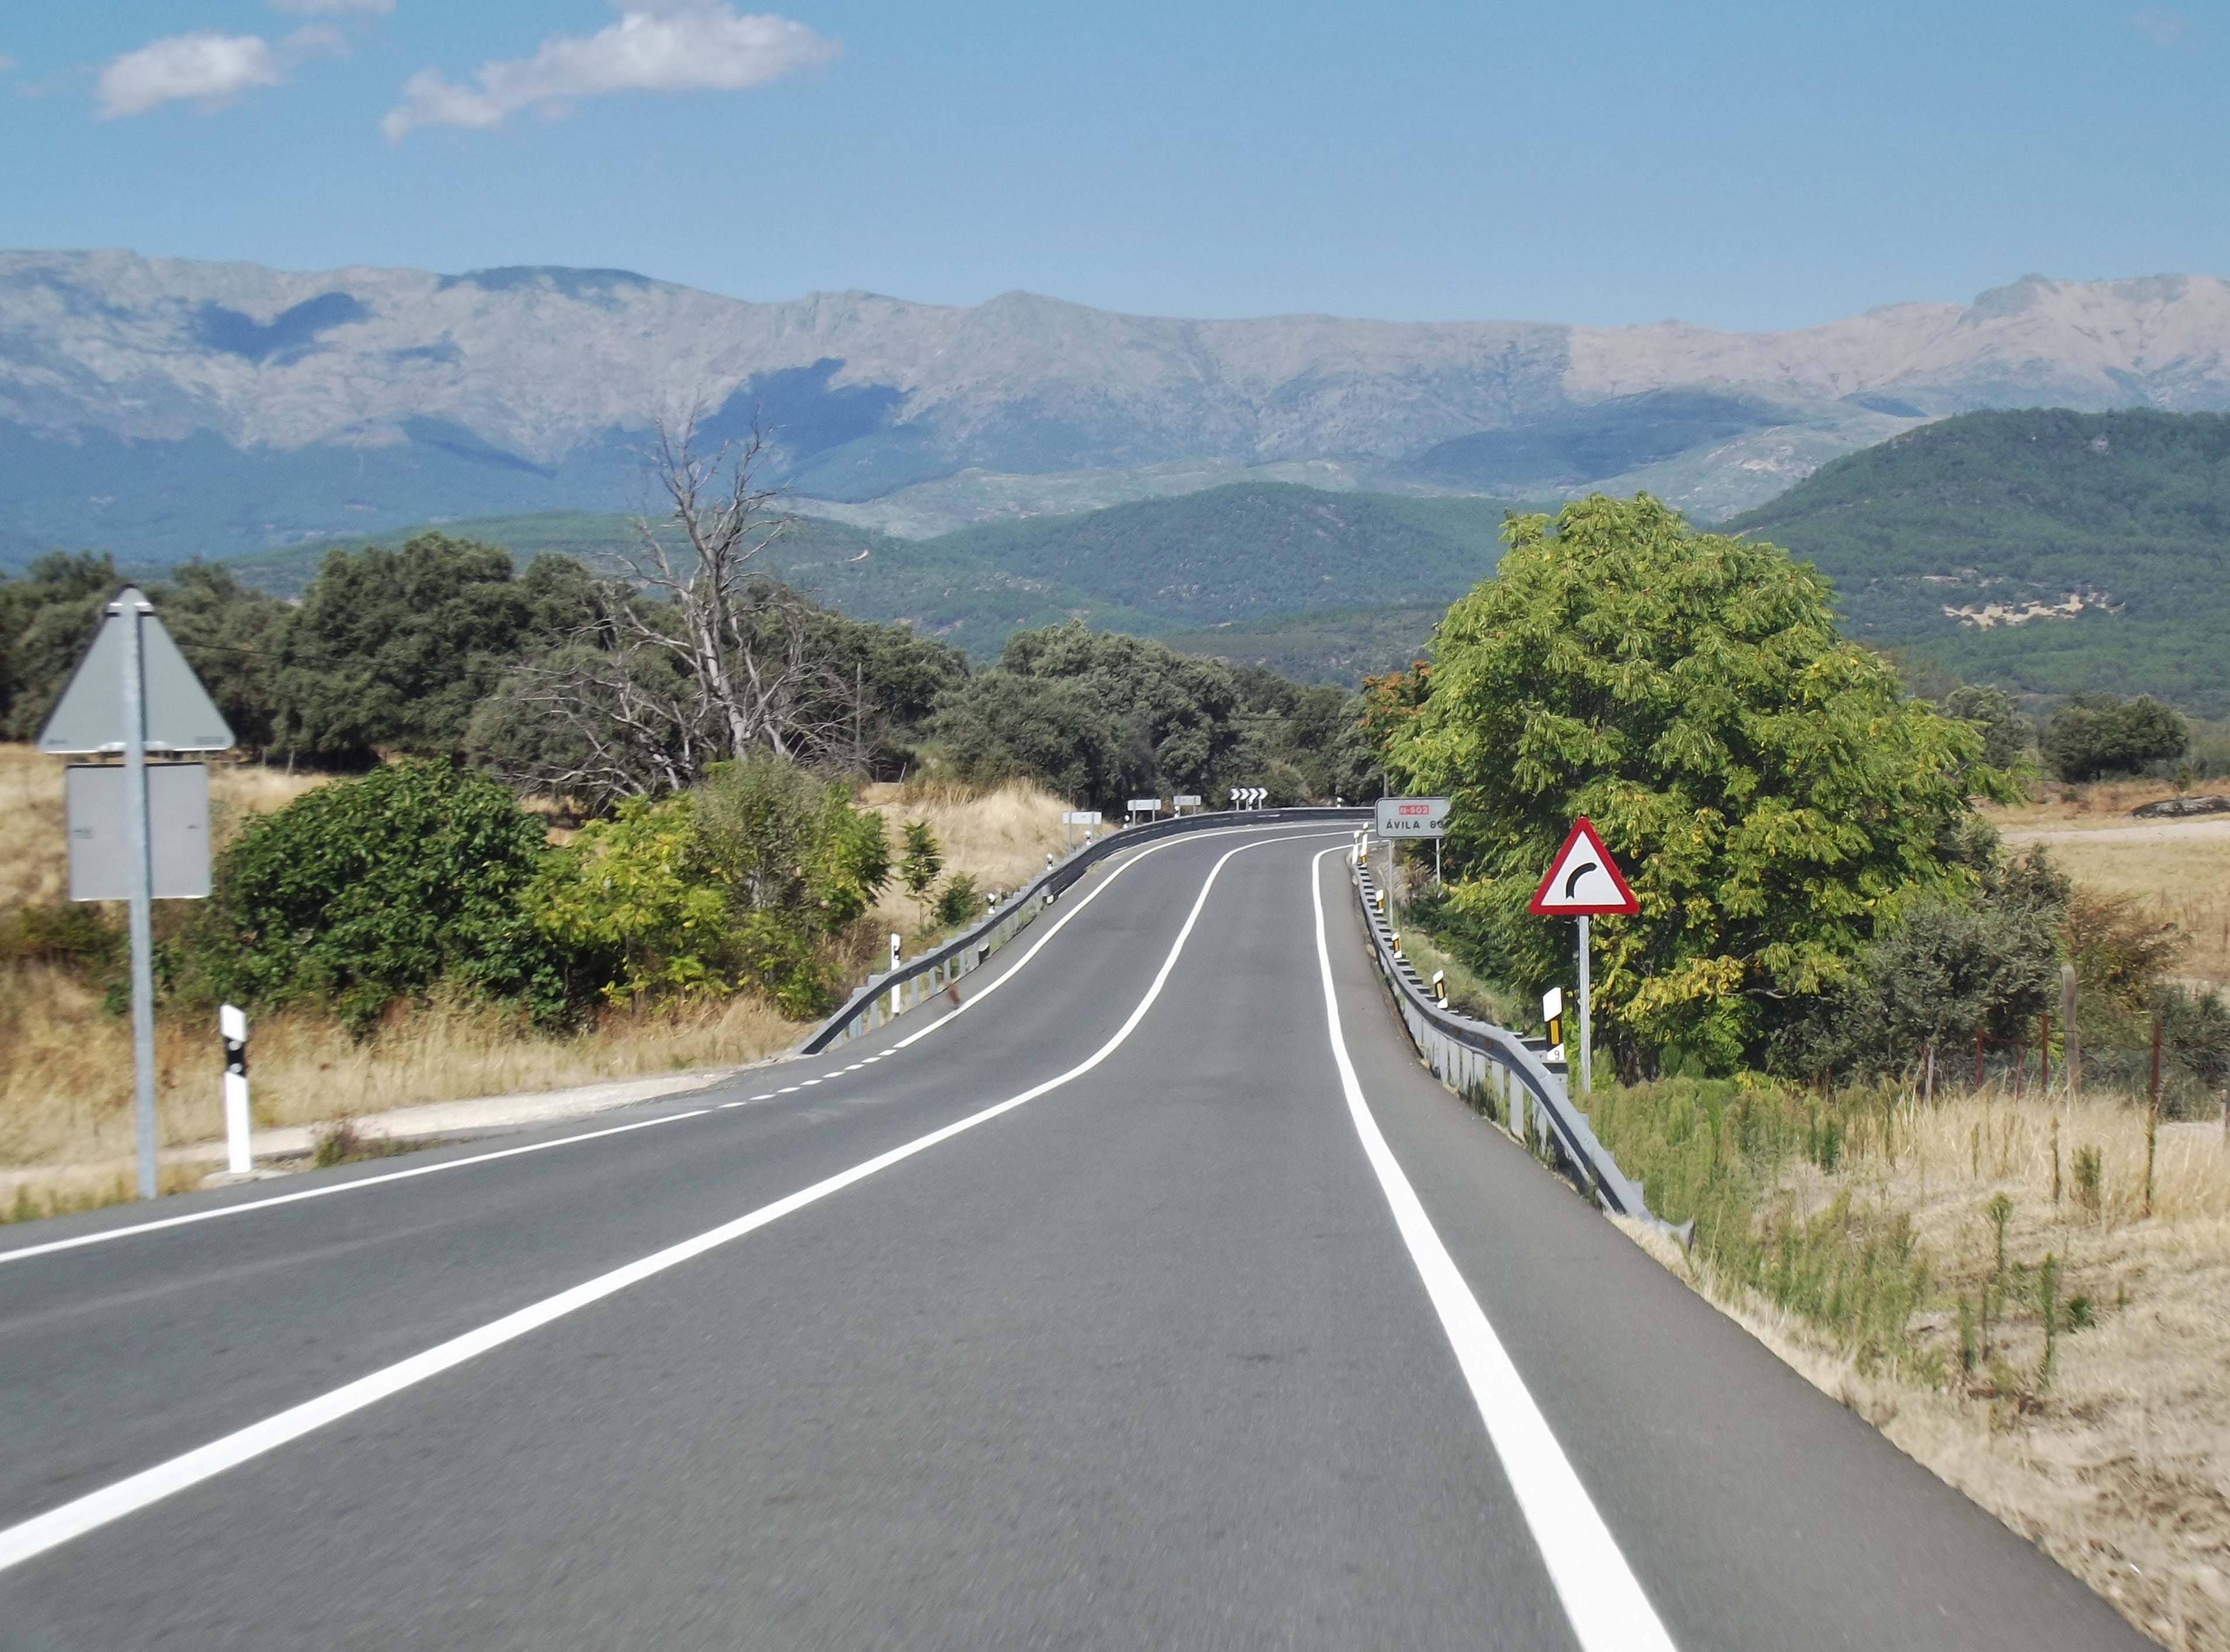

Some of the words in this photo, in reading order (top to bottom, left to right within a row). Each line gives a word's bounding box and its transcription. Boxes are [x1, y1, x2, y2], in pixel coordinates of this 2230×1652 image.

[1399, 806, 1428, 814] N-502
[1386, 818, 1420, 829] ÁVILA
[1554, 1050, 1560, 1060] 9
